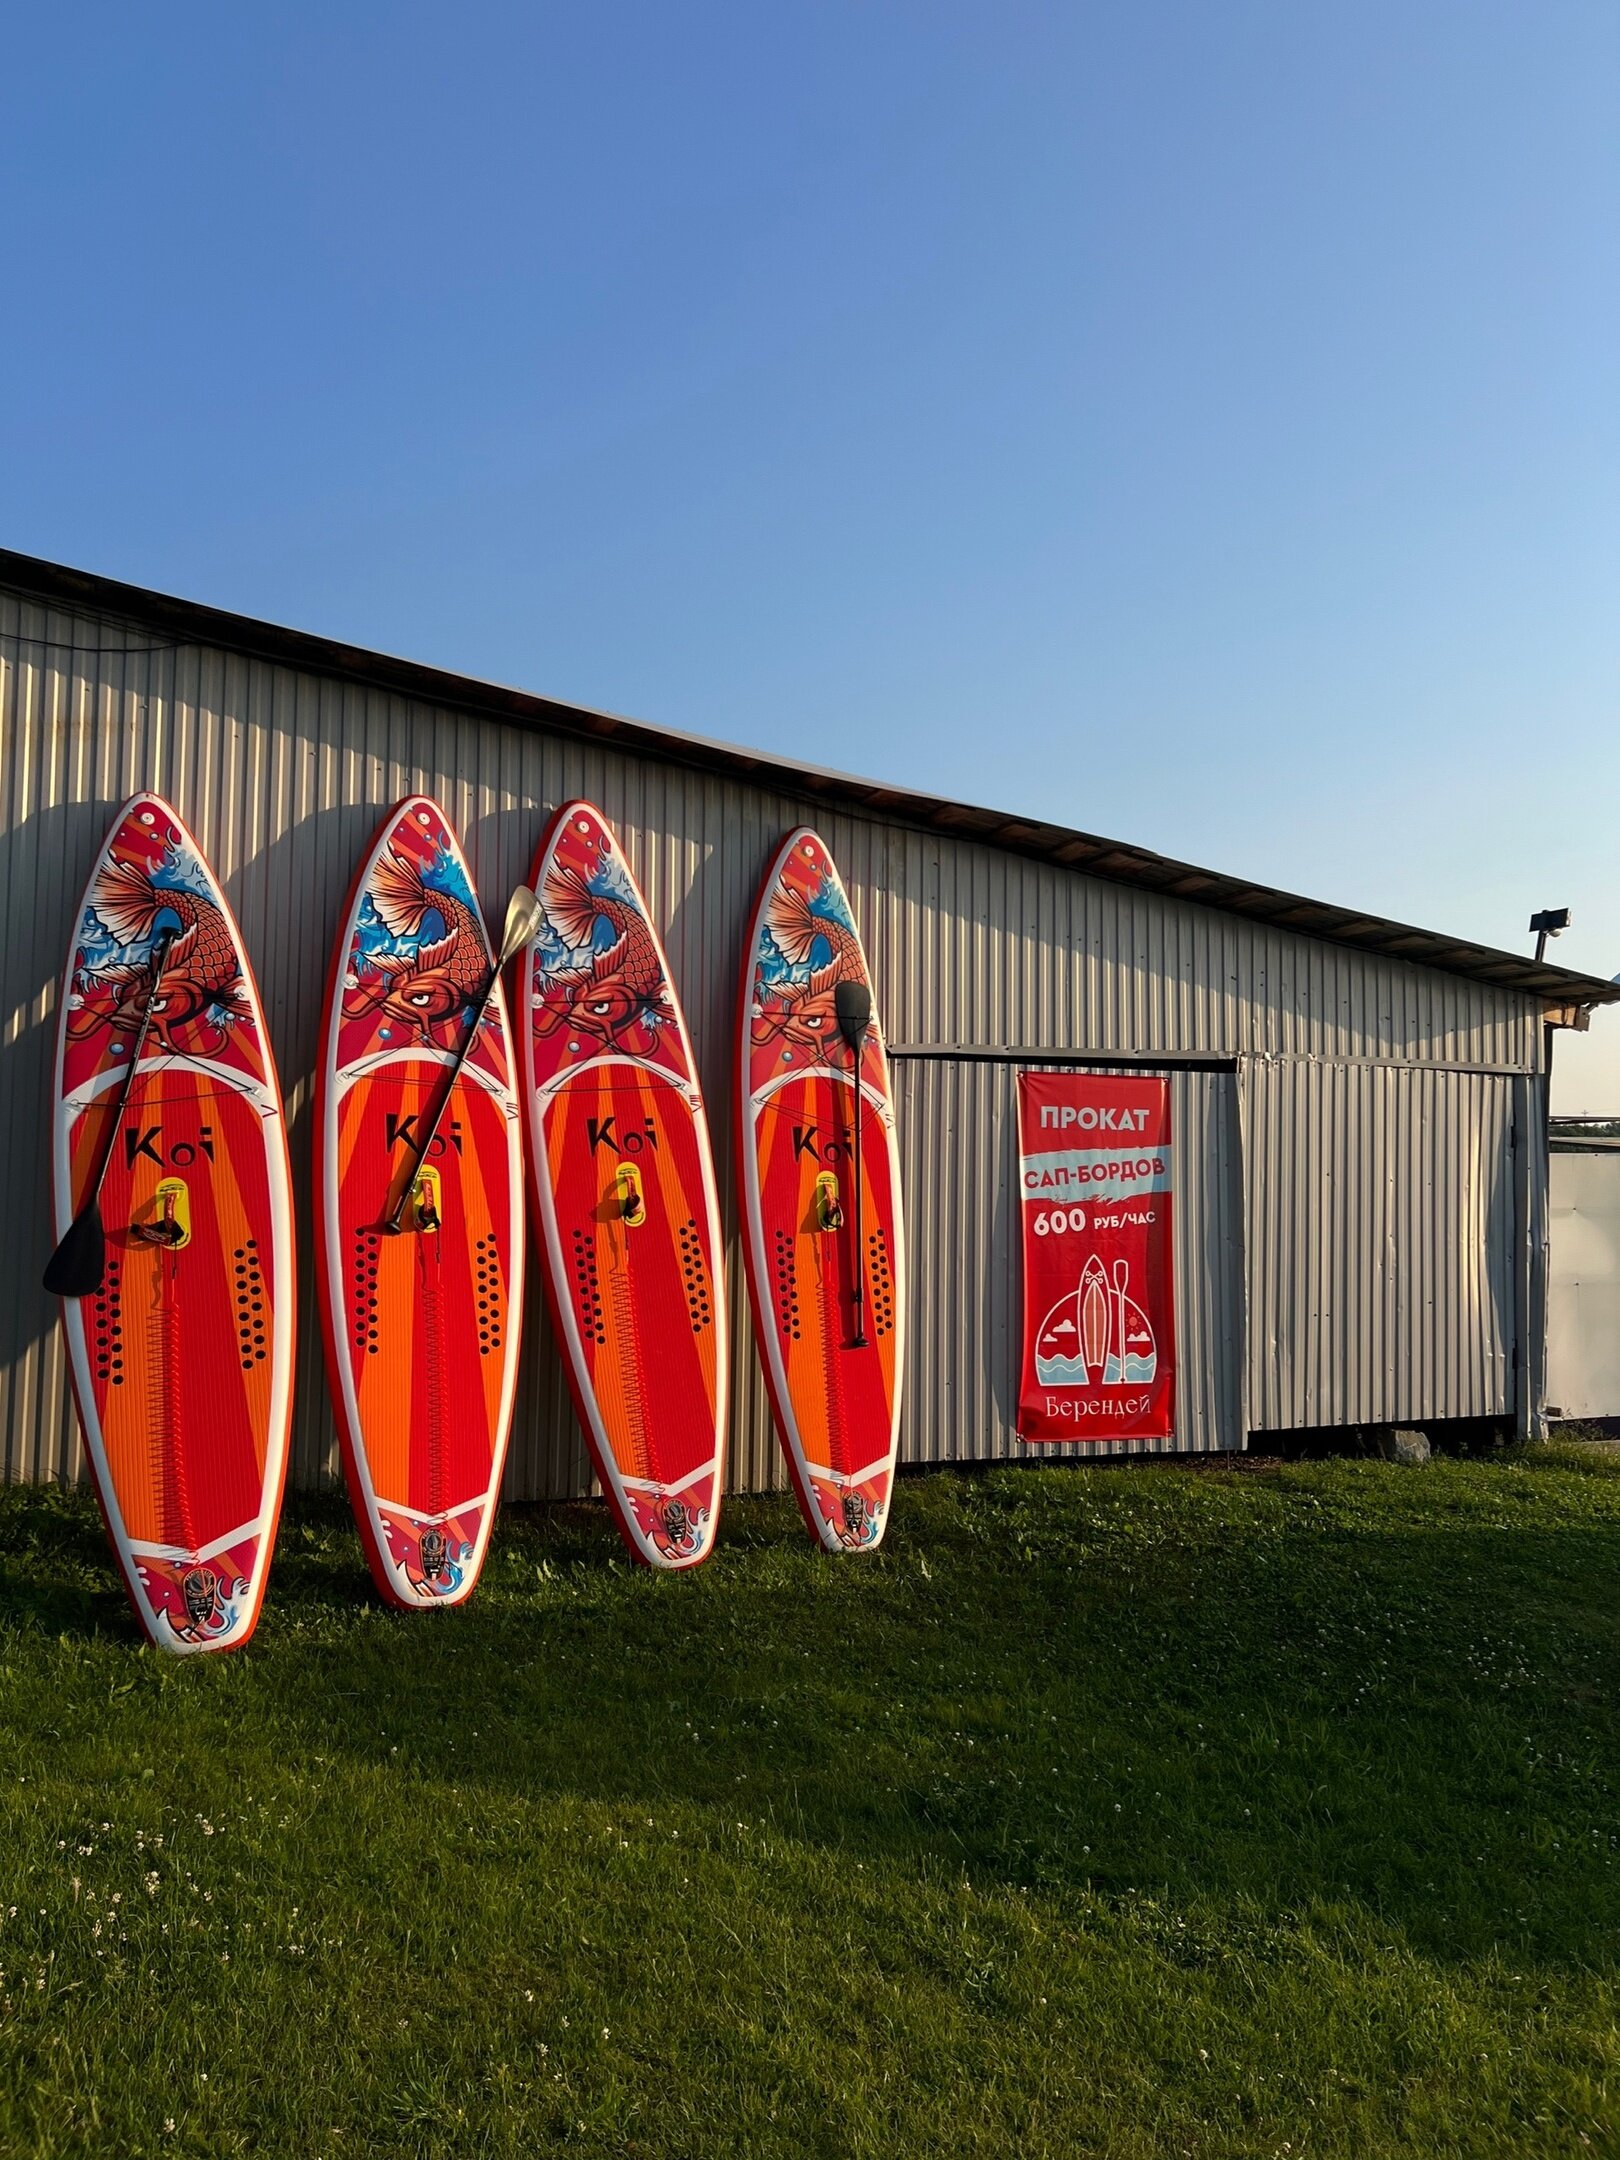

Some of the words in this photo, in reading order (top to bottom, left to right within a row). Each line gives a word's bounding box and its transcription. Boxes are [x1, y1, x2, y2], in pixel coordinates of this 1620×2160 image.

[1040, 1105, 1150, 1131] ПРОКАТ
[124, 1126, 215, 1170] Koi
[587, 1116, 658, 1157] Koi
[792, 1126, 854, 1163] Koi
[1024, 1157, 1166, 1189] САП-БОРДОВ
[1033, 1208, 1086, 1236] 600
[1094, 1210, 1156, 1230] РУБ/ЧАС
[1045, 1393, 1151, 1423] Берендей
